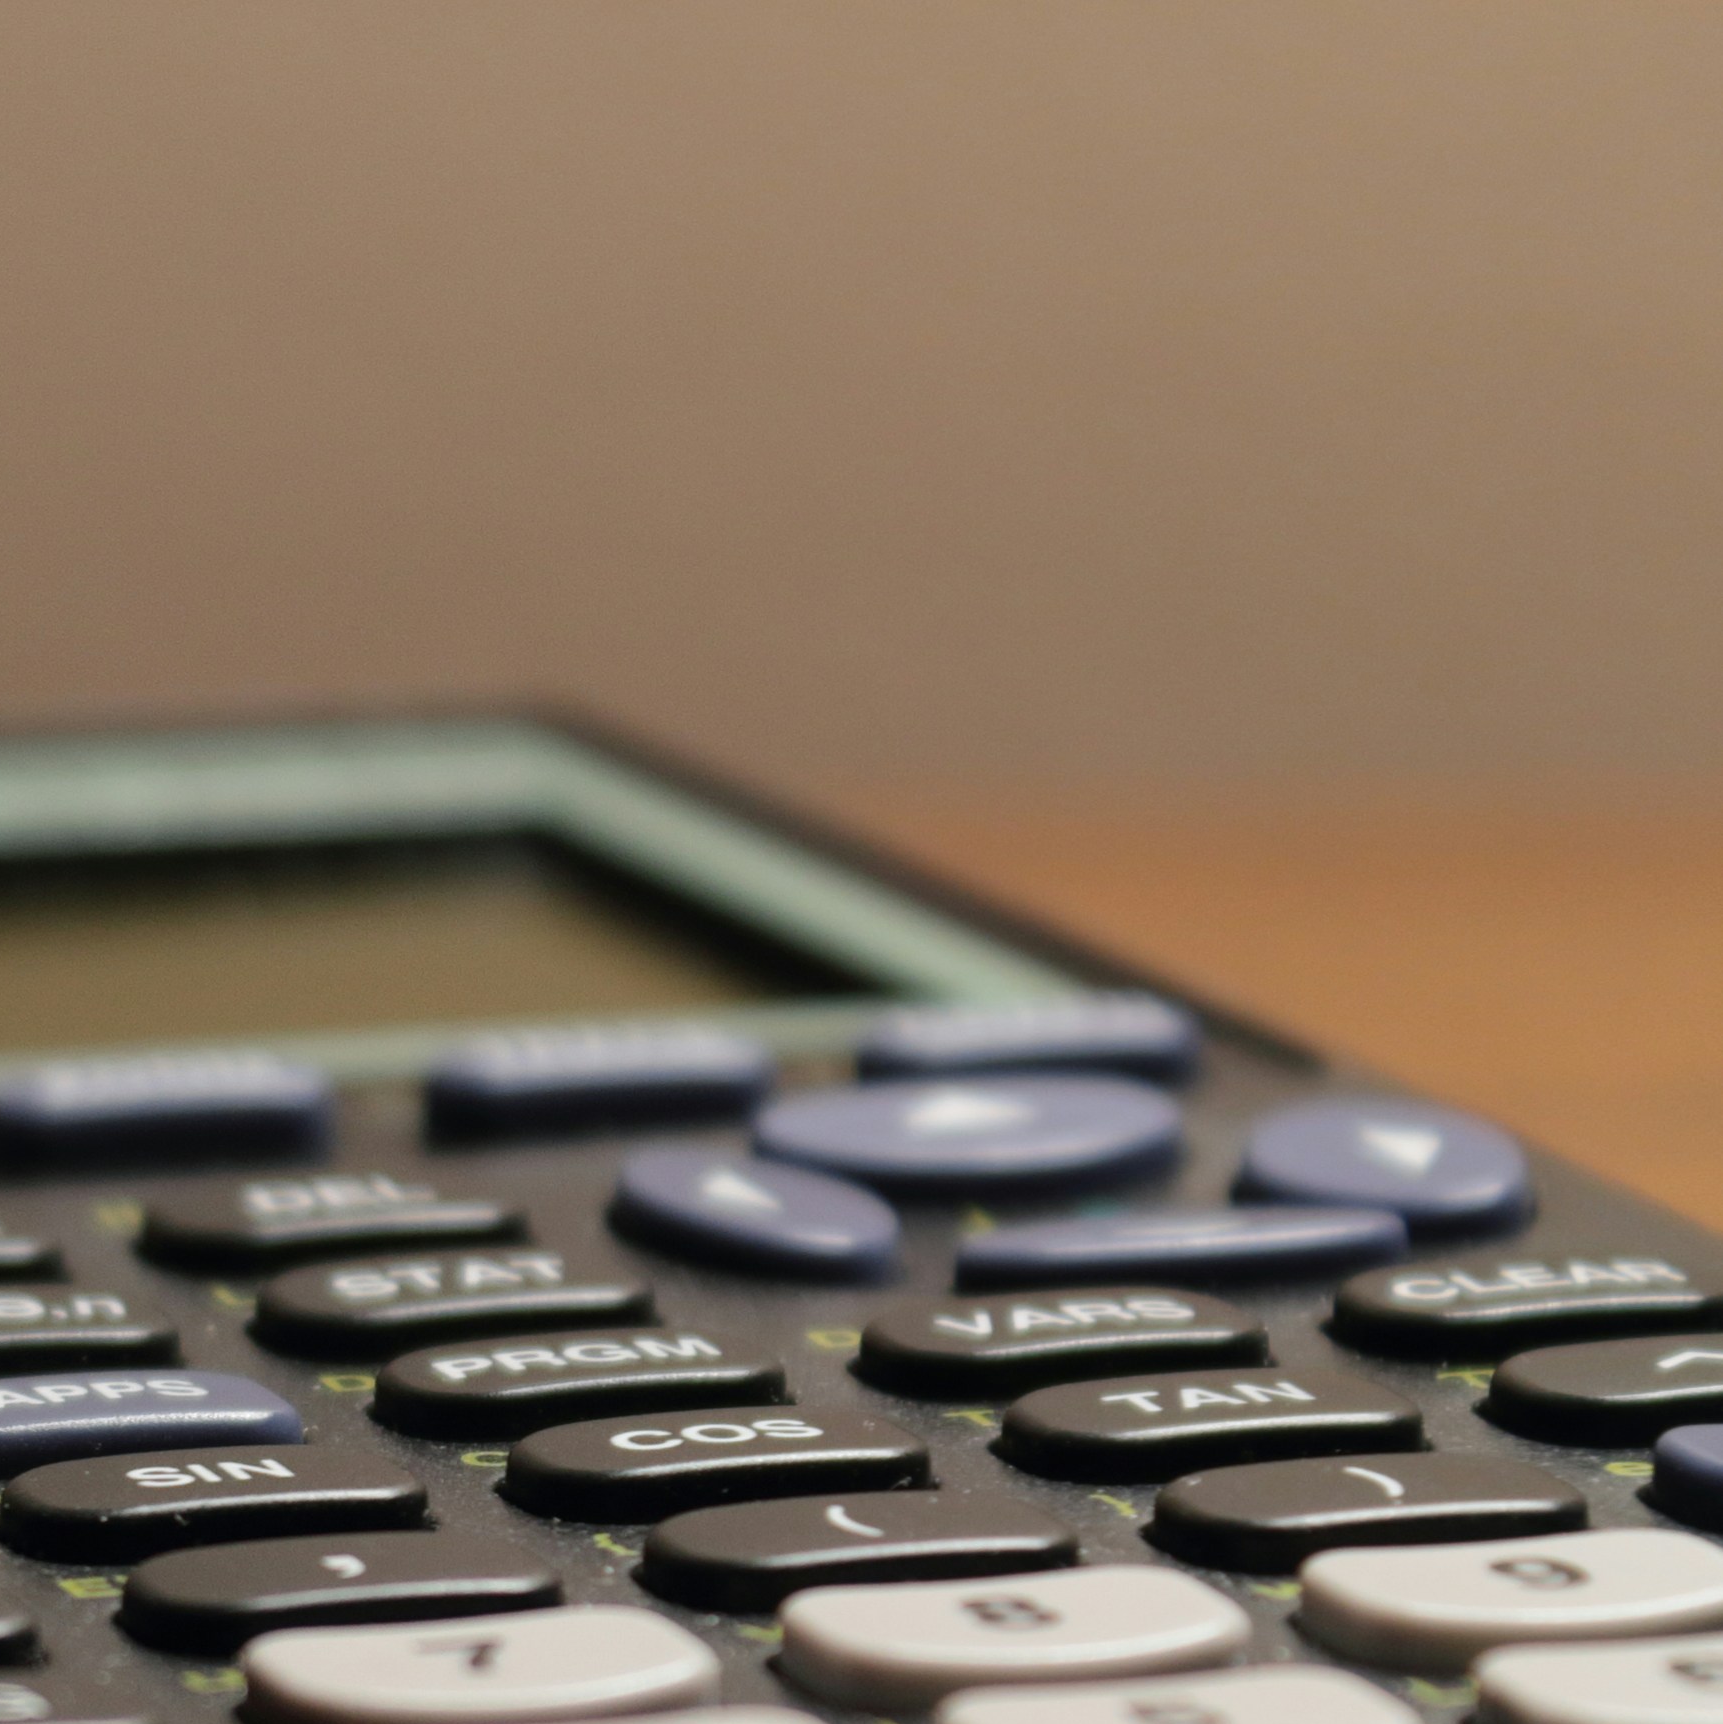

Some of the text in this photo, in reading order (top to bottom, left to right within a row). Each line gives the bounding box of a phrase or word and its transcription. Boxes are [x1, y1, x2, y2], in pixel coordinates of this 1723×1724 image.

[332, 1252, 563, 1299] STAT
[1391, 1258, 1687, 1302] CLEAR
[934, 1296, 1196, 1338] VARS
[430, 1332, 723, 1383] PRGM
[1100, 1379, 1318, 1415] TAN
[609, 1418, 825, 1452] COS
[126, 1459, 295, 1488] SIN
